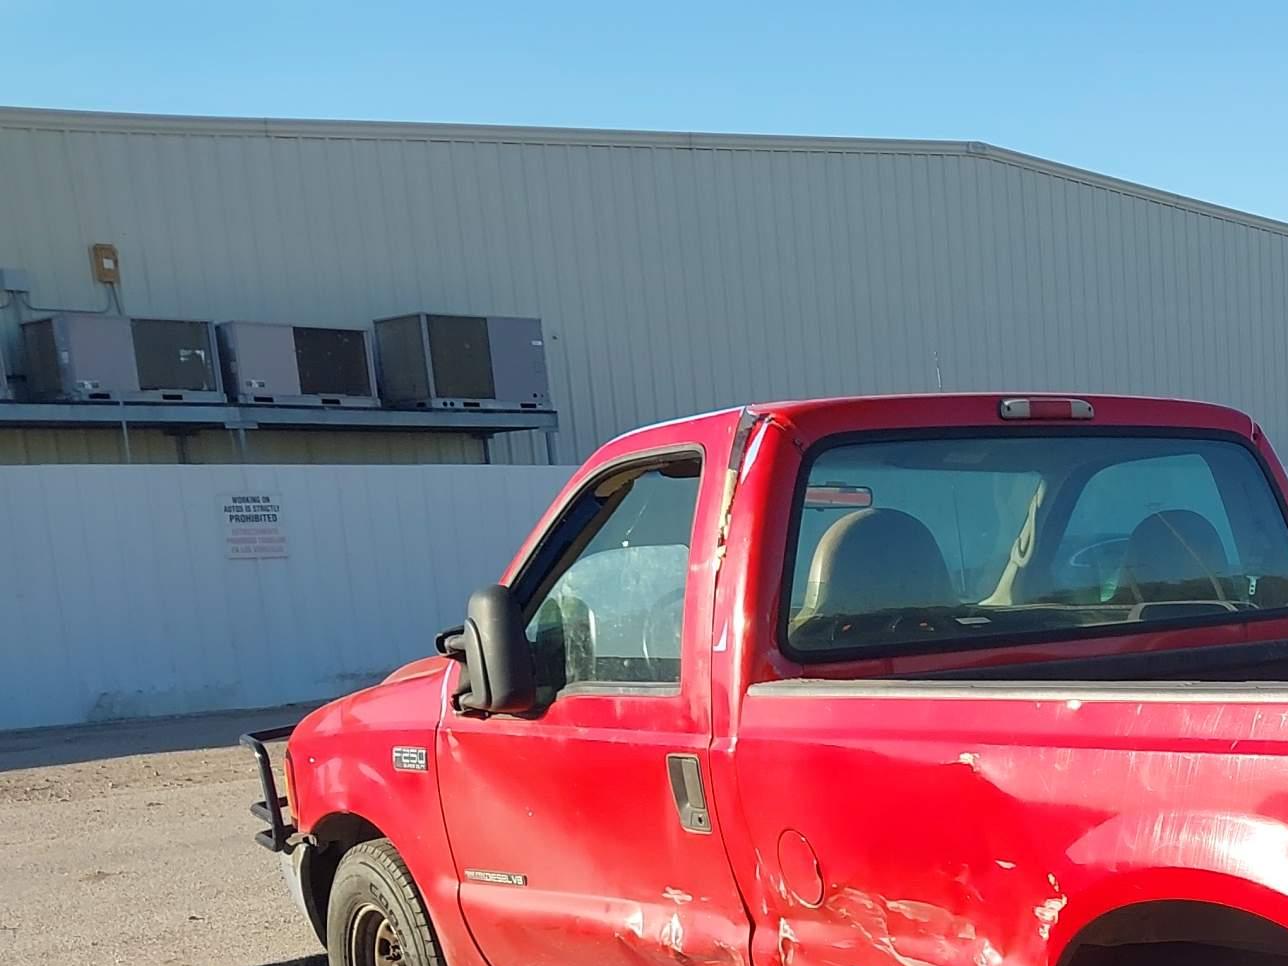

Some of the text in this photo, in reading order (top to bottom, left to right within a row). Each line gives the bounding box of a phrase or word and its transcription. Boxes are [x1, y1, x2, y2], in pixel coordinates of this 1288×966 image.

[232, 496, 270, 504] WORKING ON
[224, 504, 280, 513] AUTOS IS STRICTLY
[229, 513, 278, 523] PROHIBITED
